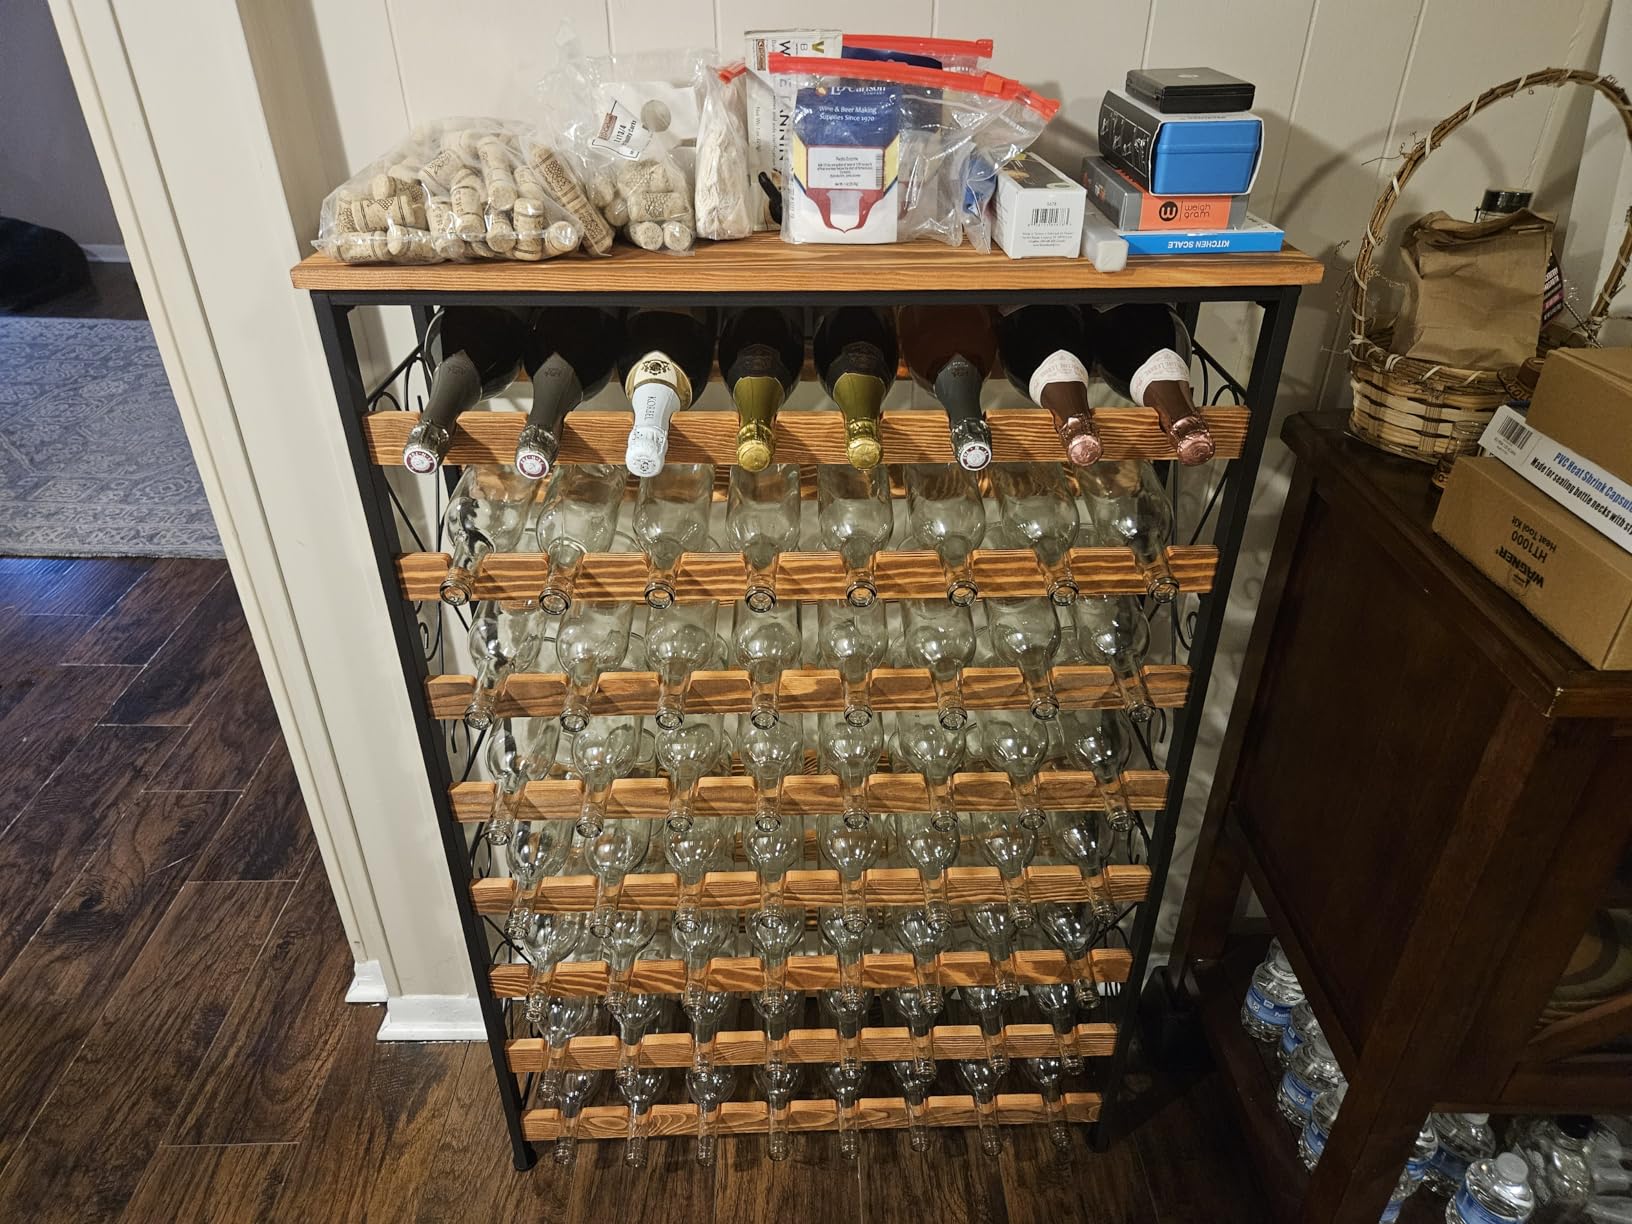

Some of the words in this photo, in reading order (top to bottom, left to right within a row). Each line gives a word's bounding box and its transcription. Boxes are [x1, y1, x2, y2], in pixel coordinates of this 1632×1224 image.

[820, 112, 844, 121] Supplies
[855, 106, 877, 115] Making
[1184, 203, 1211, 212] weigh
[1167, 241, 1195, 249] SCALE
[1195, 240, 1230, 248] KITCHEN
[1553, 452, 1570, 467] PVC
[1566, 461, 1585, 479] Heat
[1582, 471, 1609, 494] Shrink
[1530, 456, 1546, 473] Made
[1552, 473, 1576, 494] sealing
[1573, 487, 1593, 505] bottle
[1590, 499, 1611, 518] necks
[1608, 511, 1626, 529] with
[1522, 523, 1538, 540] Tool
[1511, 530, 1548, 564] HT1000
[1539, 535, 1557, 553] Heat
[1499, 545, 1544, 588] WAGNER
